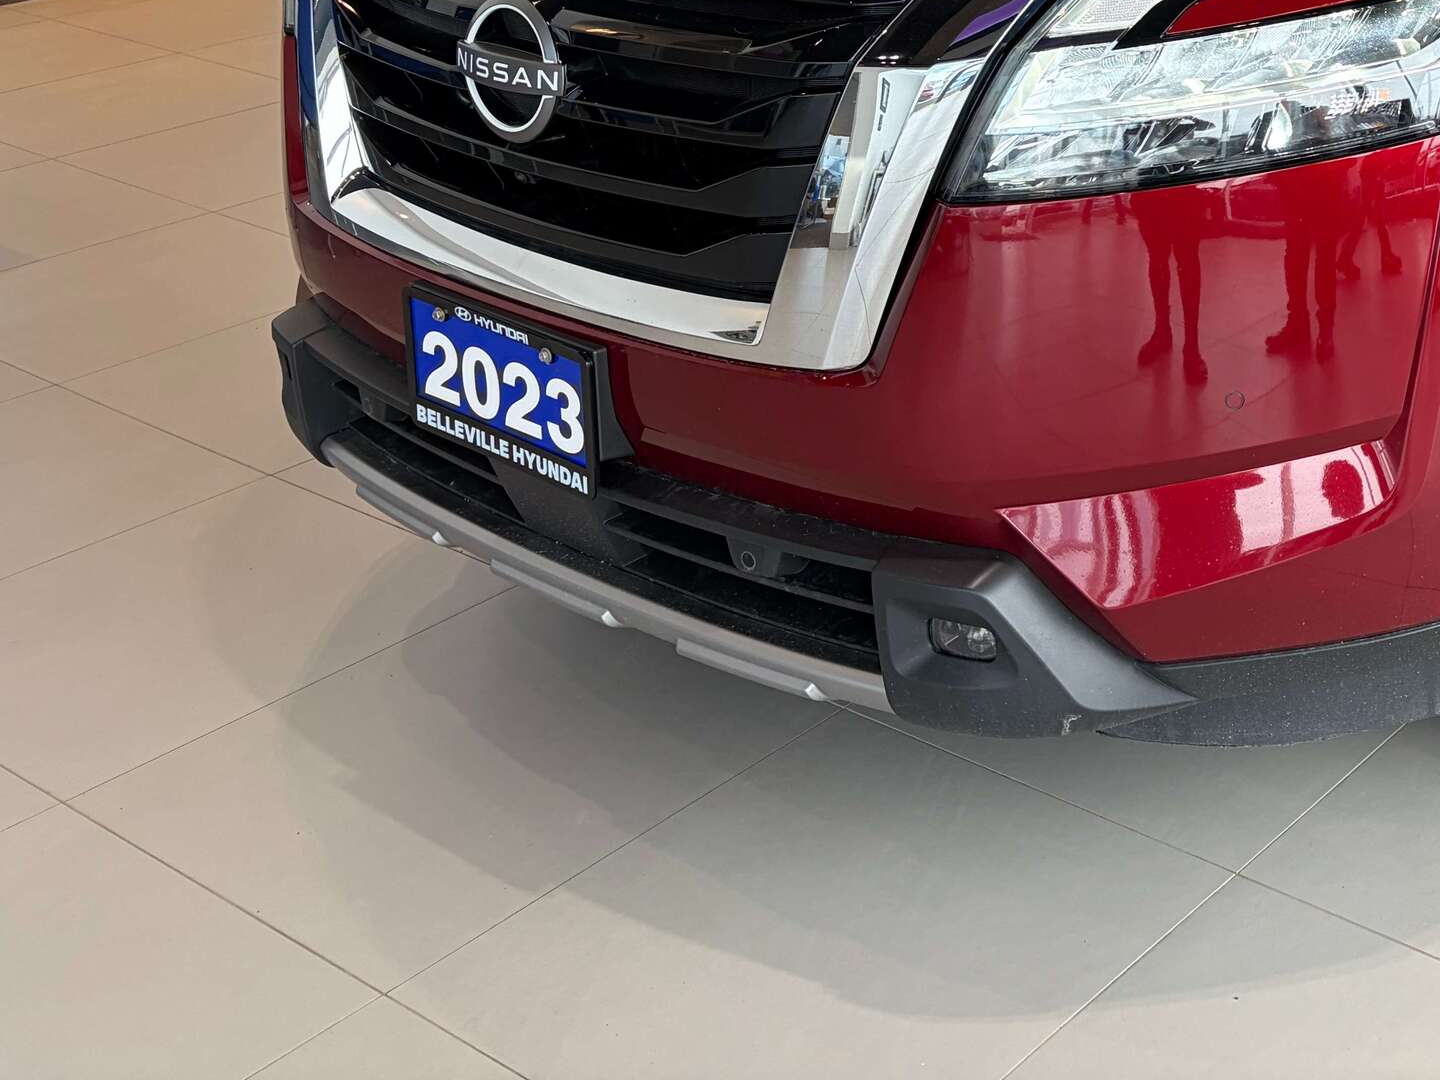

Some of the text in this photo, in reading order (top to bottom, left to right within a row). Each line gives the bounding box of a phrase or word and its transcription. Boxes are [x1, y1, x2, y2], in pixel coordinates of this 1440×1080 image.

[457, 47, 559, 91] NISSAN
[473, 314, 529, 345] HYUNDAI
[422, 330, 585, 455] 2023
[416, 403, 589, 495] BELLEVILLE HYUNDAI
